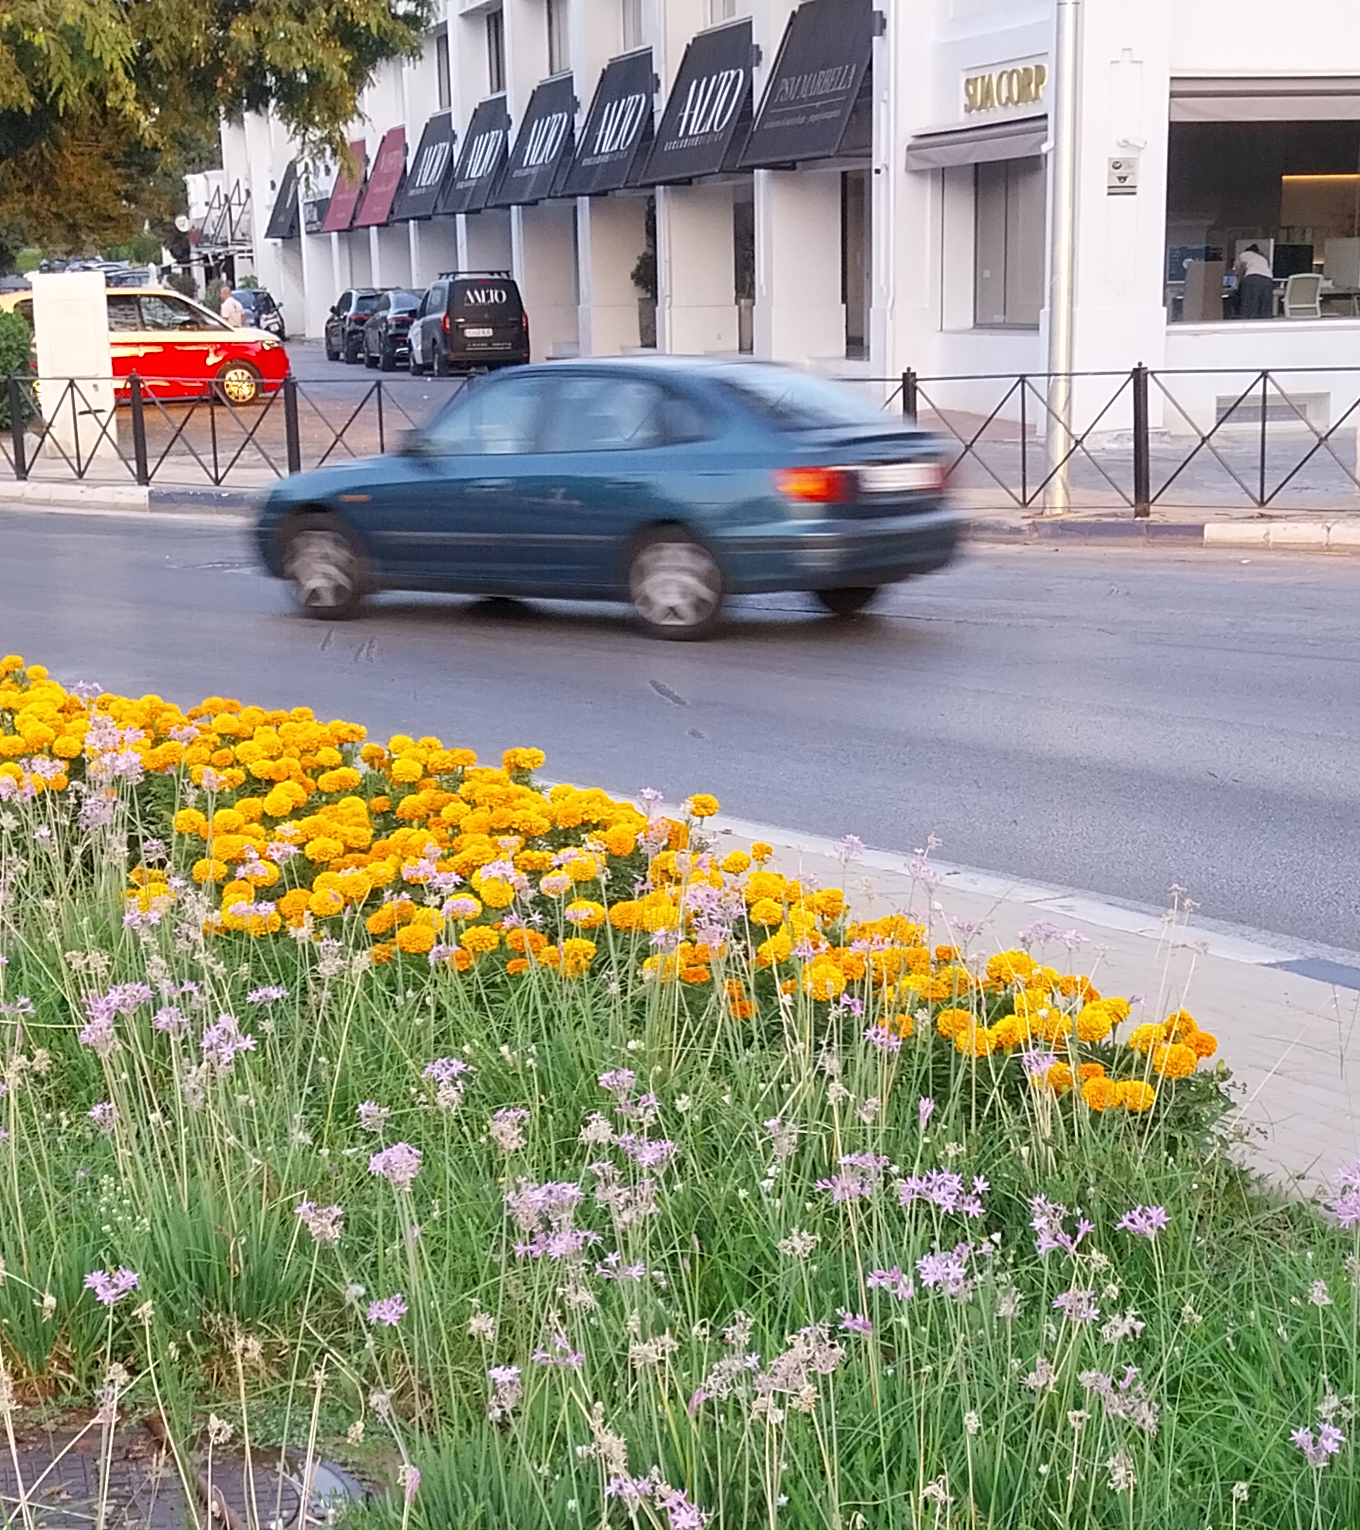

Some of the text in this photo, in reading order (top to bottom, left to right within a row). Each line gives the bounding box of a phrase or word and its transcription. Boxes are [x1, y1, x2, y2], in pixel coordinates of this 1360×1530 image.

[672, 68, 745, 138] AALTO
[796, 63, 856, 99] MARBELLA
[522, 111, 568, 168] AALTO
[589, 92, 646, 155] AALTO
[464, 288, 507, 304] AALTO
